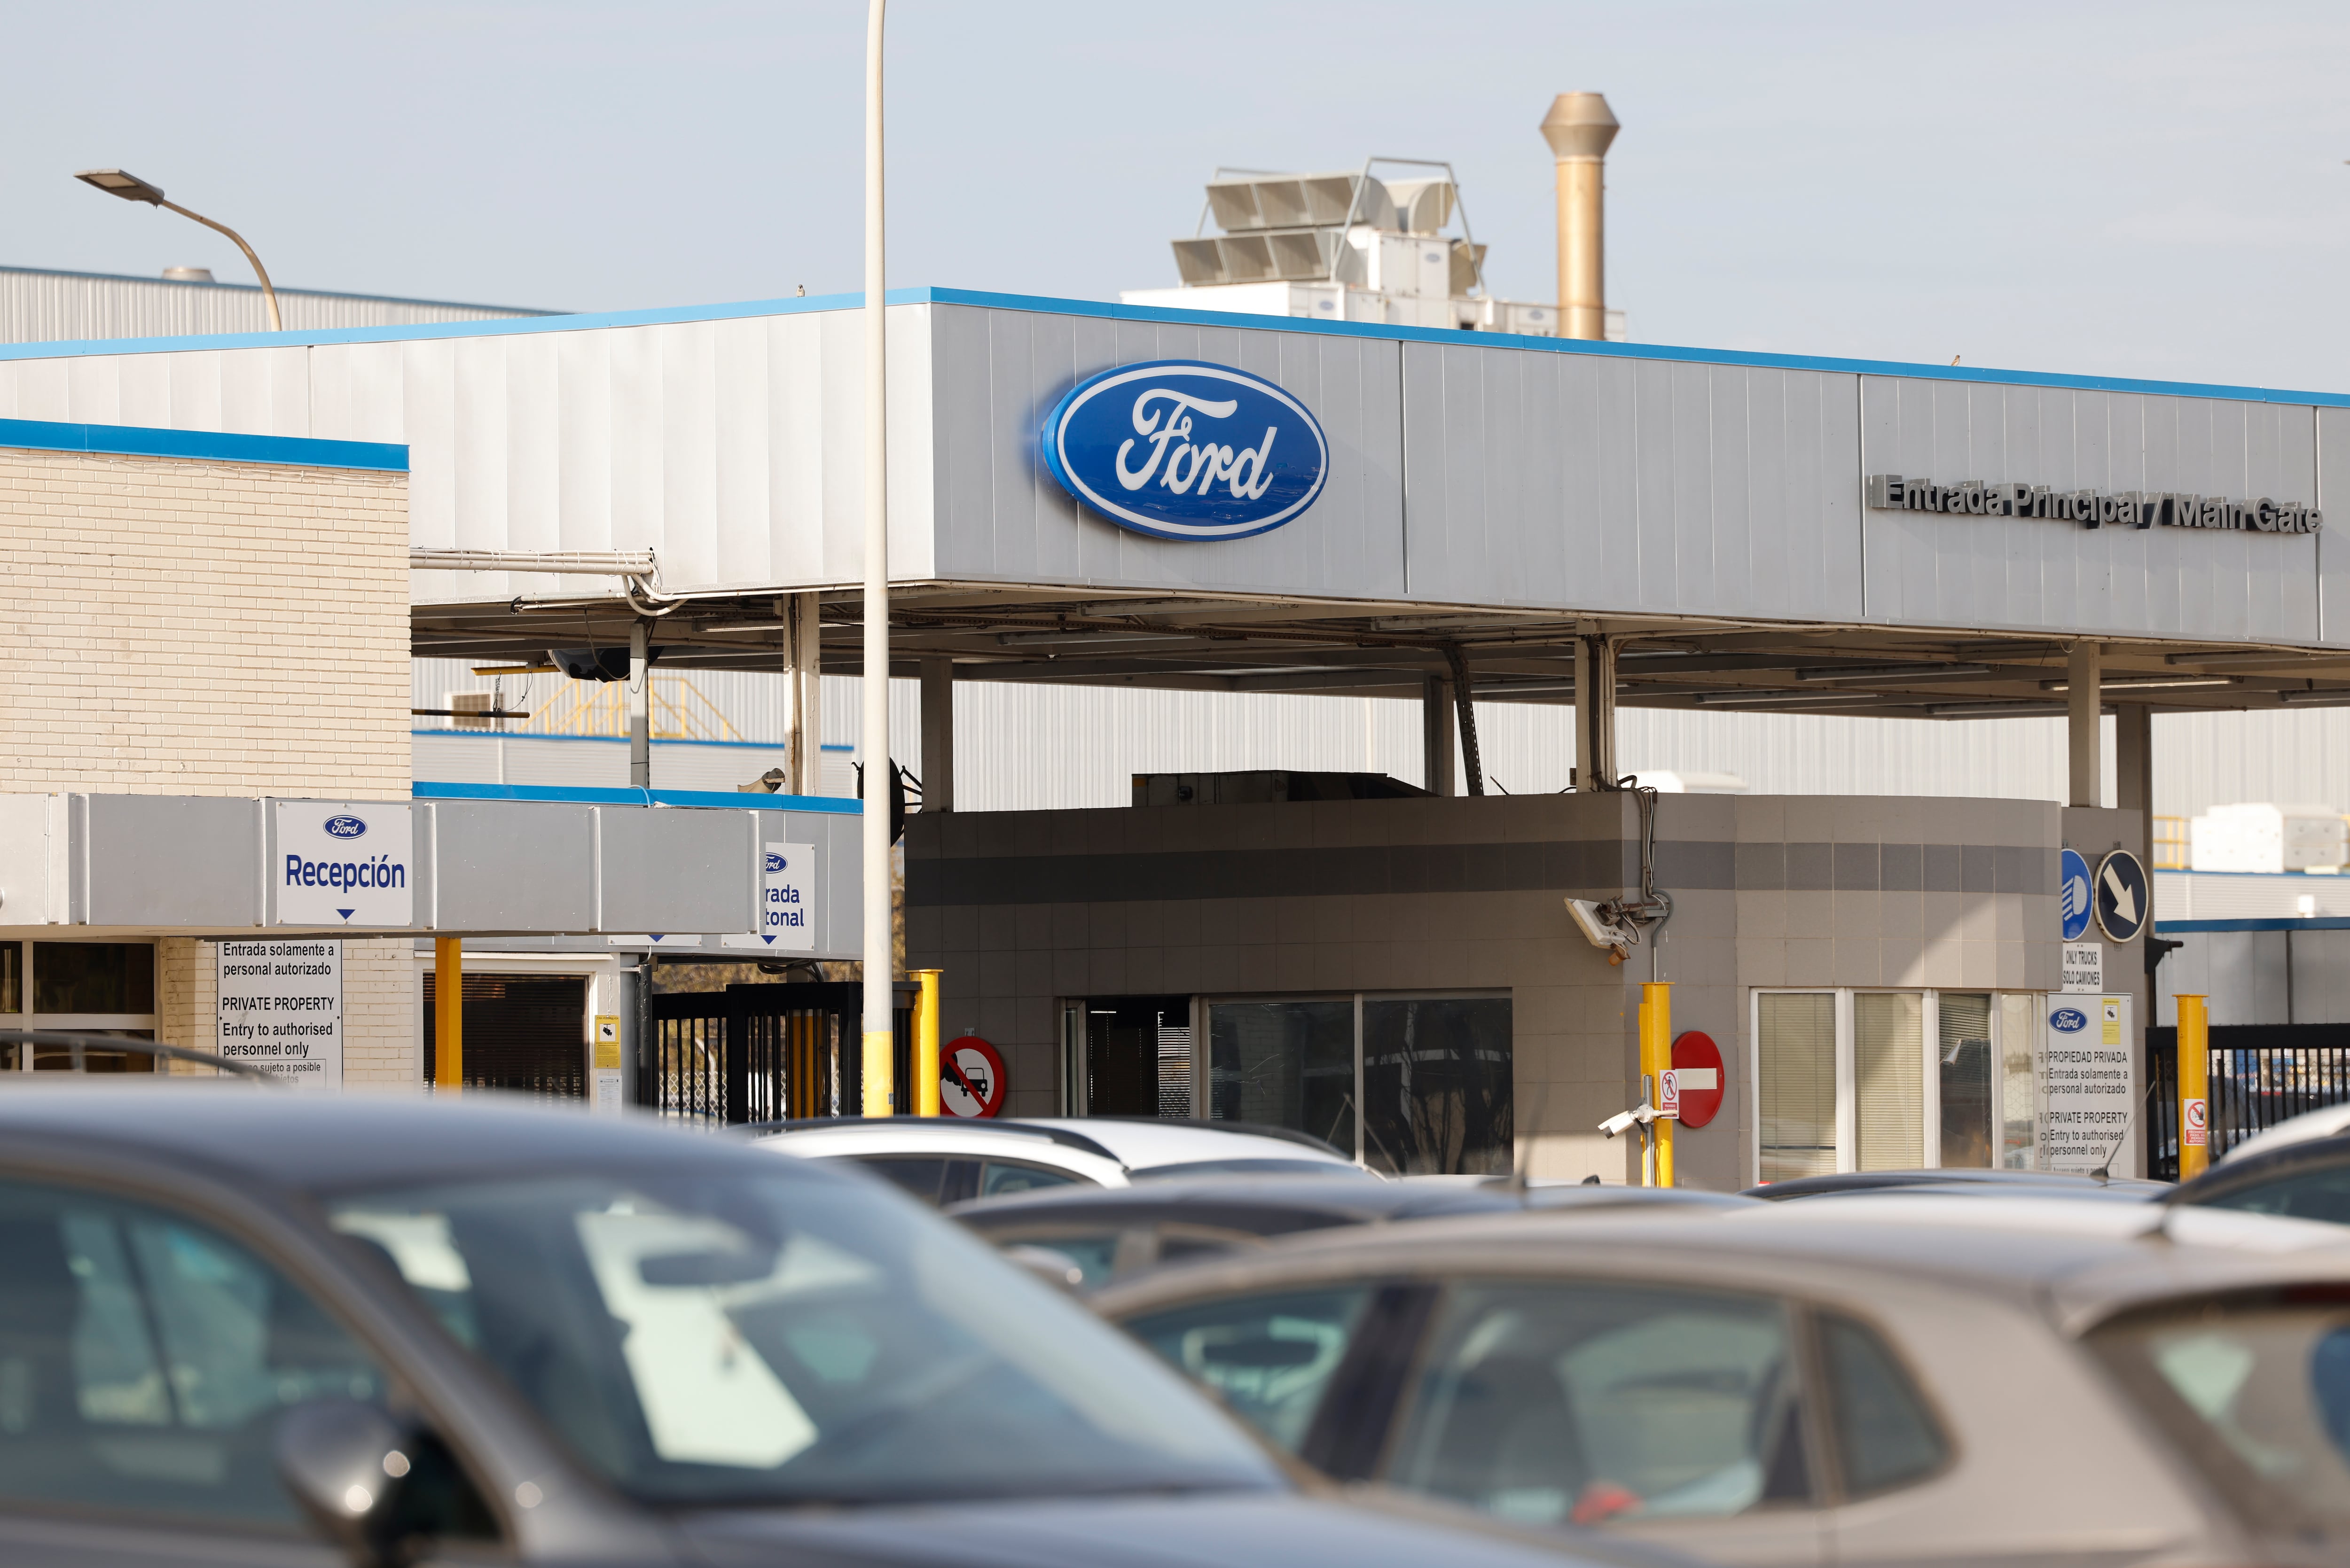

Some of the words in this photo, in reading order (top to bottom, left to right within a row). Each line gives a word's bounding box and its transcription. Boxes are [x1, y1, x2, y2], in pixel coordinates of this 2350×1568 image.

[1115, 388, 1277, 500] Ford
[1884, 474, 2004, 515] Entrada
[2012, 483, 2143, 530] Principal
[2149, 491, 2166, 530] /
[2174, 492, 2246, 530] Main
[2253, 497, 2324, 534] Gate
[331, 819, 359, 834] Ford
[286, 854, 405, 894] Recepción
[224, 943, 266, 956] Entrada
[270, 943, 325, 956] solamente
[328, 945, 334, 956] a
[2066, 950, 2077, 965] ONLY
[2078, 951, 2097, 965] TRUCKS
[224, 962, 271, 978] personal
[275, 962, 331, 975] autorizado
[2063, 970, 2075, 984] SOLO
[2076, 971, 2100, 985] CAMIONES
[223, 997, 271, 1011] PRIVATE
[274, 997, 334, 1010] PROPERTY
[2056, 1011, 2080, 1029] Ford
[223, 1022, 254, 1039] Entry
[258, 1023, 269, 1036] to
[273, 1022, 333, 1035] authorised
[224, 1042, 281, 1058] personnel
[285, 1041, 309, 1058] only
[2049, 1051, 2092, 1063] PROPIEDAD
[2094, 1052, 2127, 1063] PRIVADA
[260, 1063, 284, 1073] sujeto
[293, 1062, 321, 1074] posible
[2049, 1068, 2078, 1079] Entrada
[2080, 1068, 2121, 1079] solamente
[2049, 1083, 2082, 1096] personal
[2084, 1083, 2126, 1094] autorizado
[2050, 1112, 2081, 1123] PRIVATE
[2084, 1112, 2128, 1123] PROPERTY
[2050, 1129, 2070, 1143] Entry
[2072, 1130, 2079, 1140] to
[2082, 1129, 2123, 1140] authorised
[2050, 1144, 2088, 1158] personnel
[2090, 1144, 2107, 1158] only
